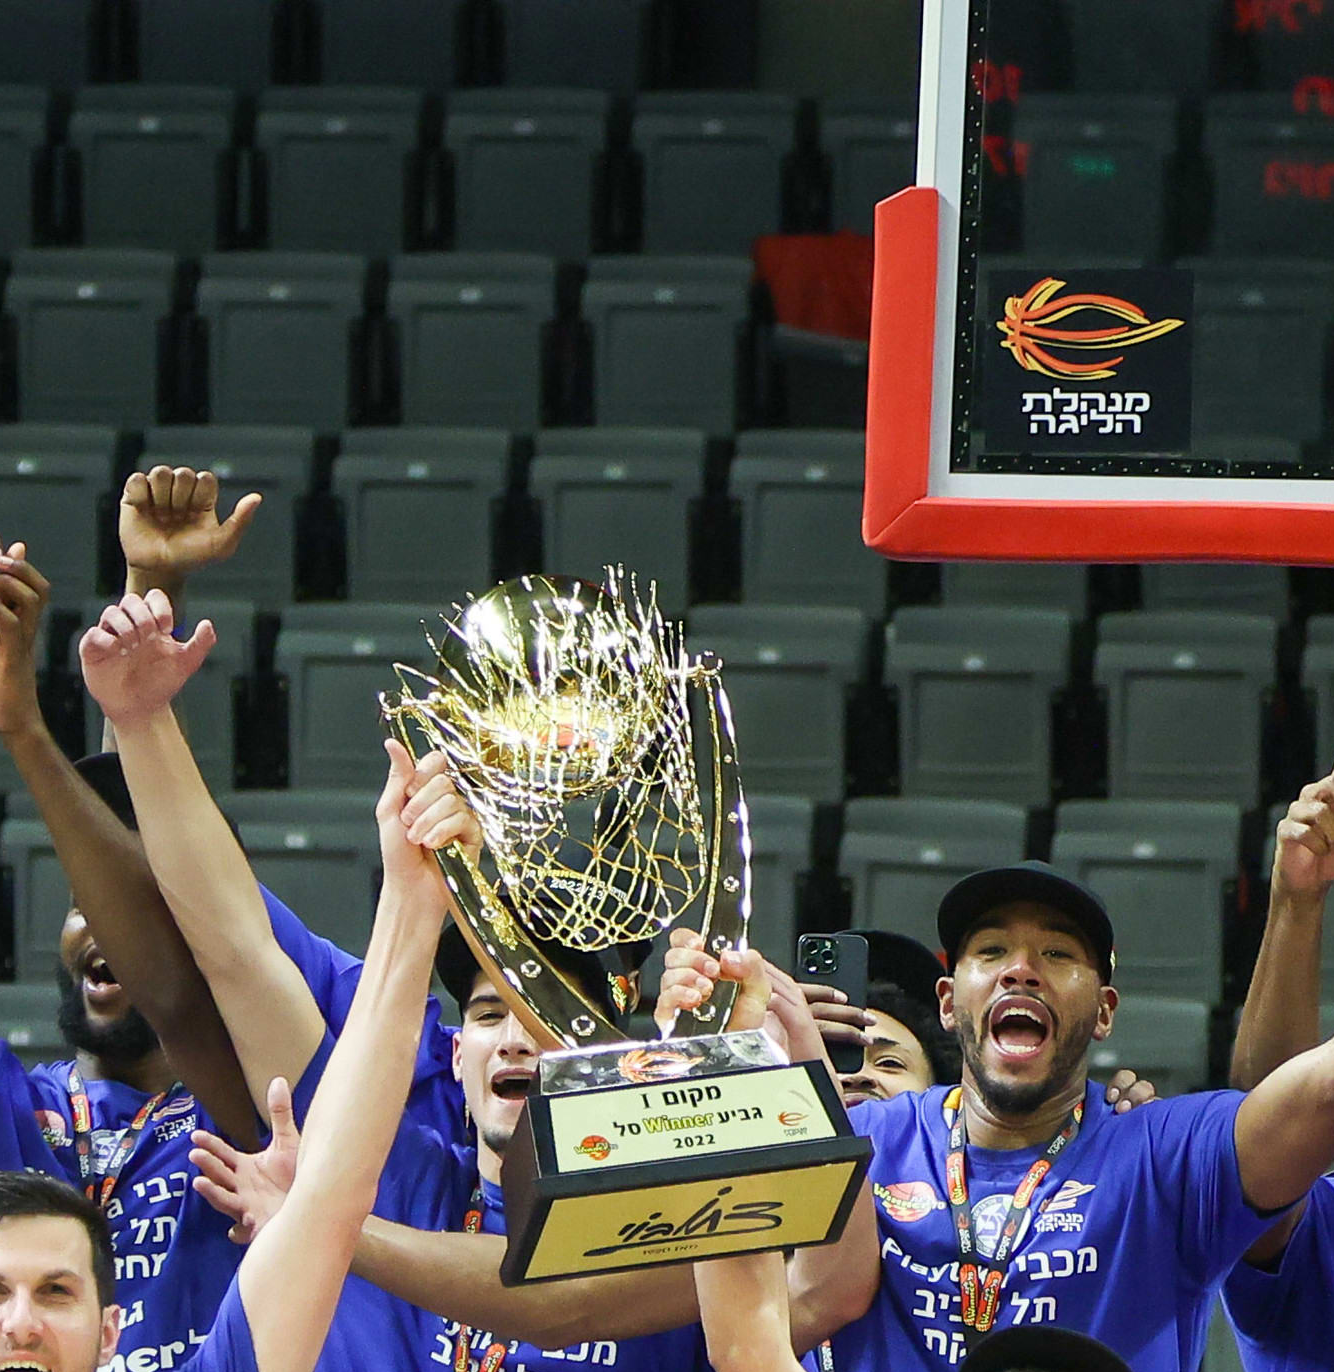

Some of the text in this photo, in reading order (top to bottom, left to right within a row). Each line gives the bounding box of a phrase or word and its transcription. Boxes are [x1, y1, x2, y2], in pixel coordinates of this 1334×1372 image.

[1021, 388, 1151, 415] מנהלת
[1028, 411, 1143, 436] הליגה
[661, 1084, 723, 1107] מקום
[613, 1104, 764, 1138] גביע Winner סל
[673, 1133, 717, 1150] 2022
[1015, 1245, 1098, 1281] מכבי
[1010, 1291, 1057, 1325] תל
